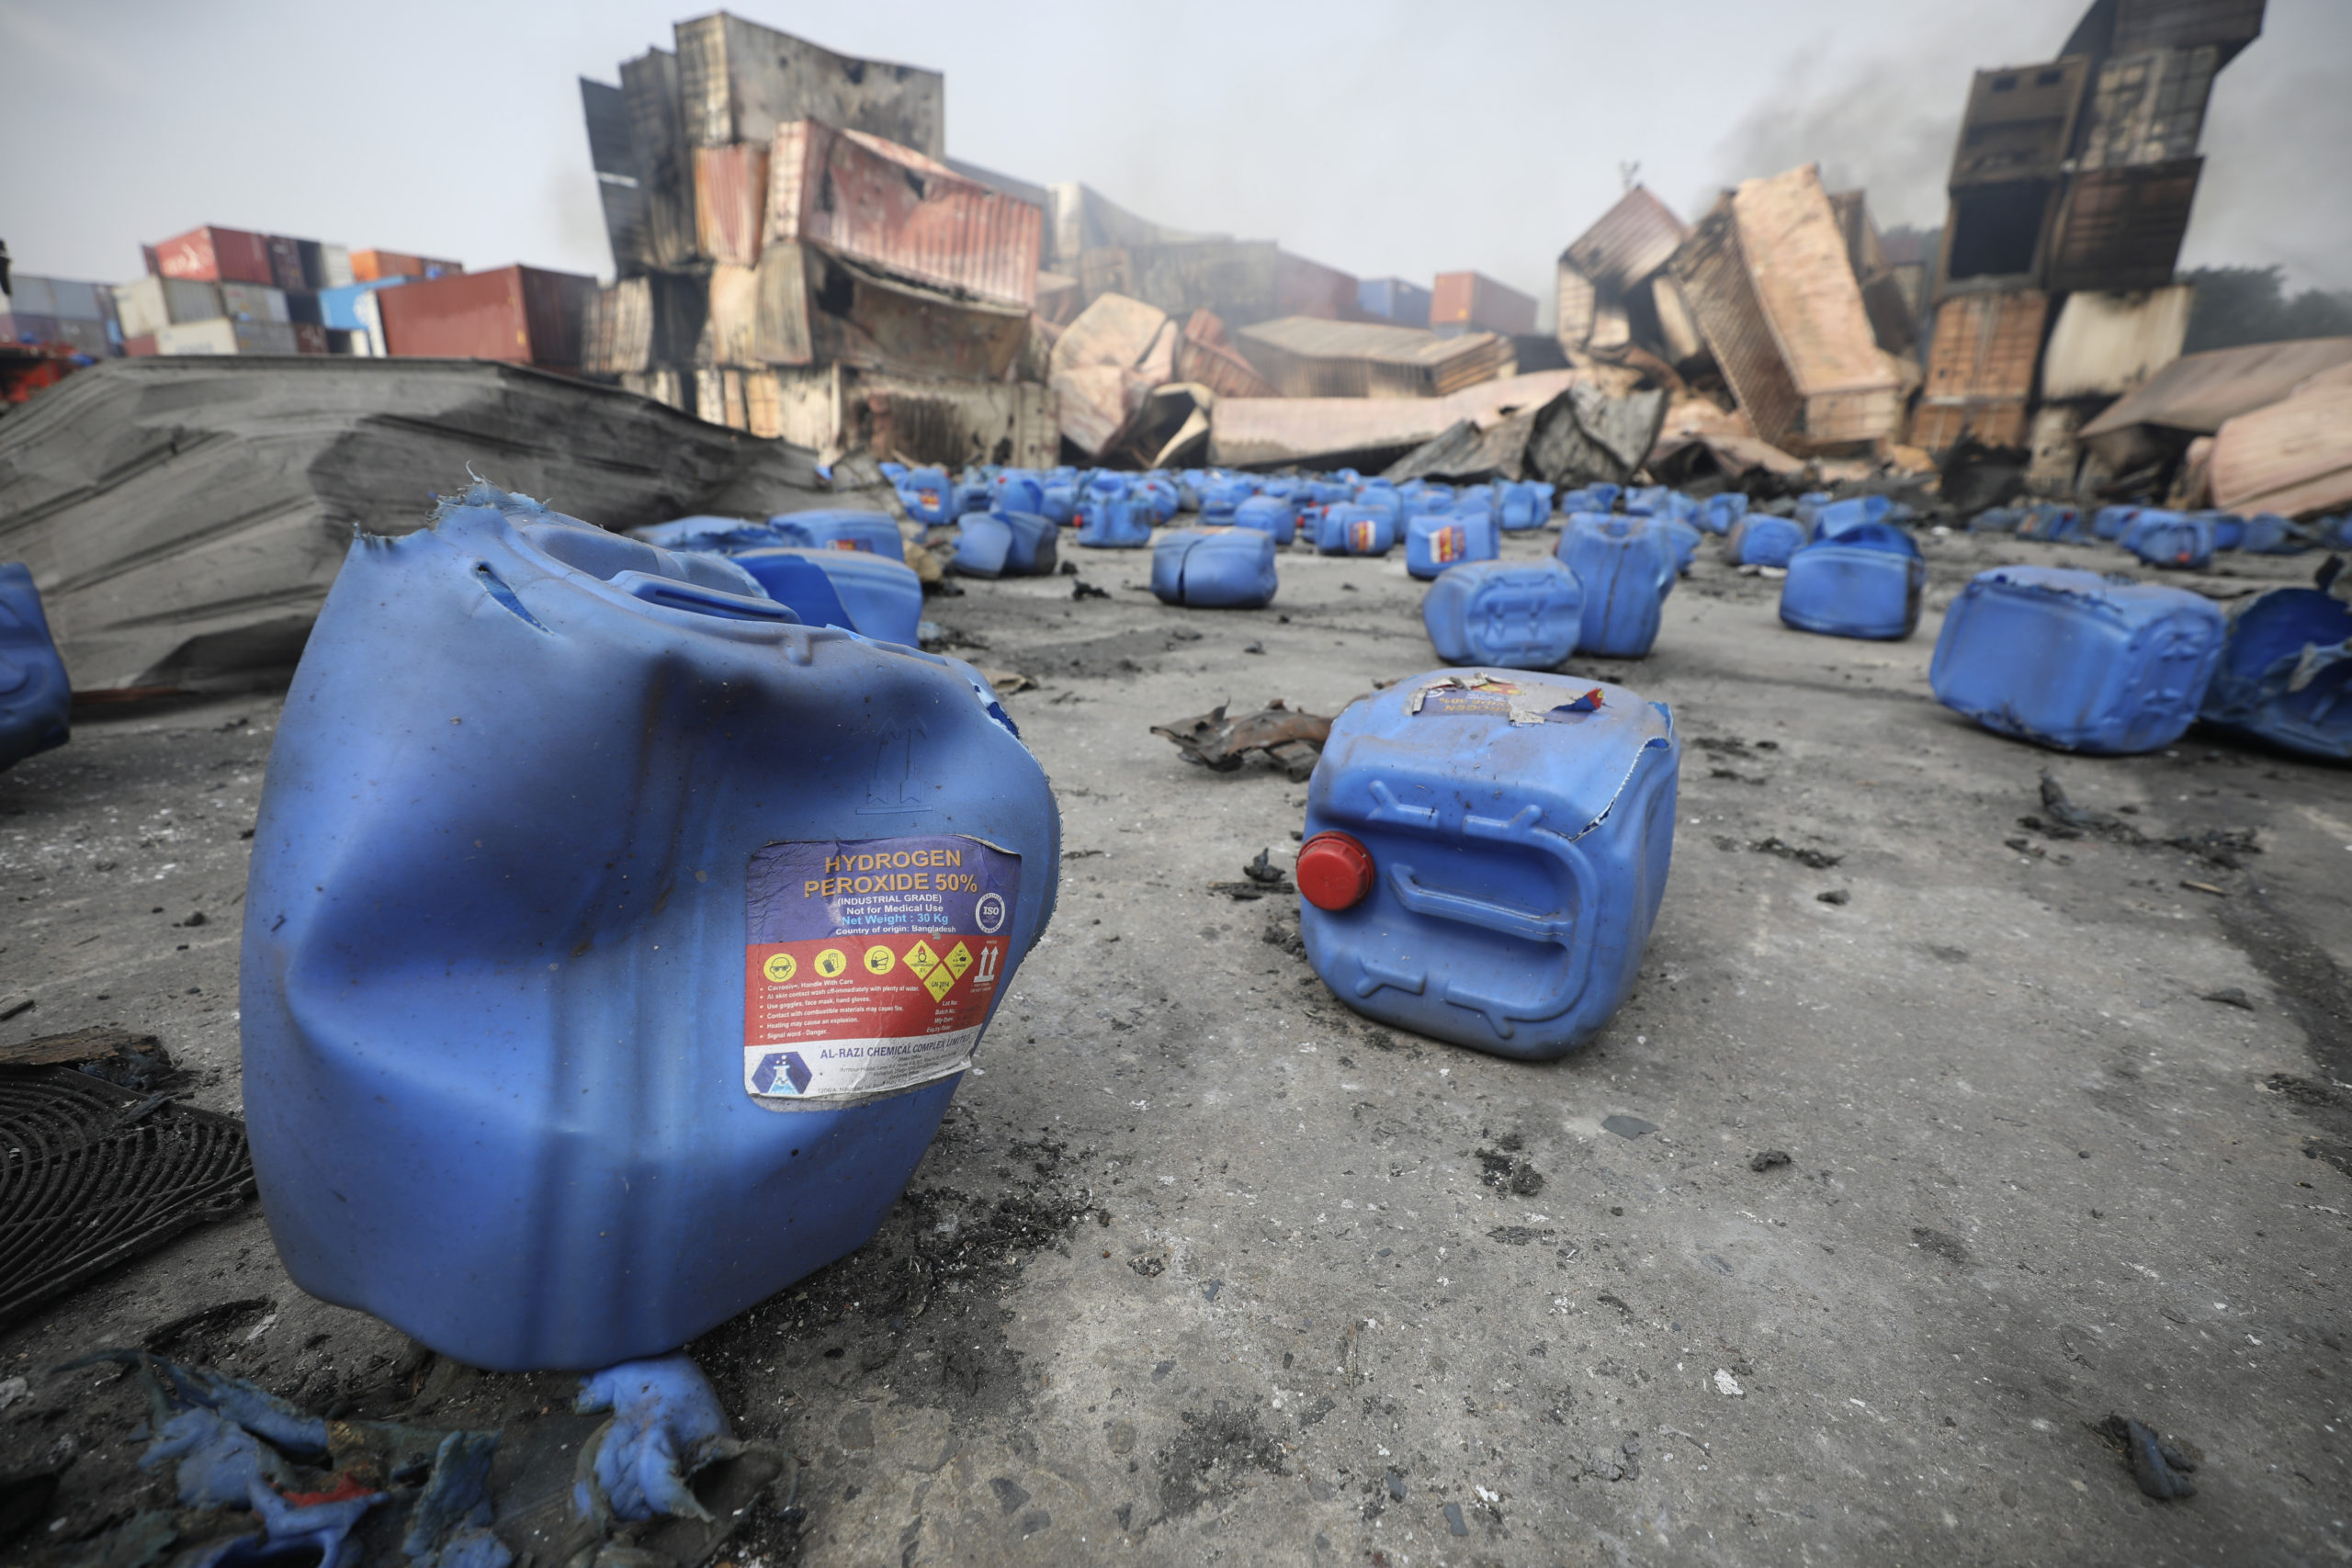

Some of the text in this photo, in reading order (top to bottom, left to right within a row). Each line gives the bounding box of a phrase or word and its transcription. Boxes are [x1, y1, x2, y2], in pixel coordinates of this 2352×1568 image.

[826, 850, 962, 874] HYDROGEN
[804, 873, 978, 898] PEROXIDE 50%
[837, 894, 943, 906] (INDUSTRIAL GRADE)
[846, 907, 865, 915] Not
[884, 904, 922, 913] Medical
[925, 904, 944, 912] Use
[983, 907, 1000, 916] ISO
[842, 916, 864, 926] Net
[865, 915, 907, 925] Weight
[917, 914, 930, 922] 30
[933, 914, 949, 925] Kg
[835, 927, 869, 936] Country
[882, 925, 910, 935] origin:
[911, 925, 956, 935] Bangladesh
[883, 986, 899, 994] plenty
[819, 998, 835, 1007] mask,
[851, 996, 871, 1005] gloves.
[804, 1008, 839, 1016] combustible
[766, 1021, 789, 1030] Heating
[820, 1034, 971, 1059] AL-RAZI CHEMICAL COMPLEX LIMITED
